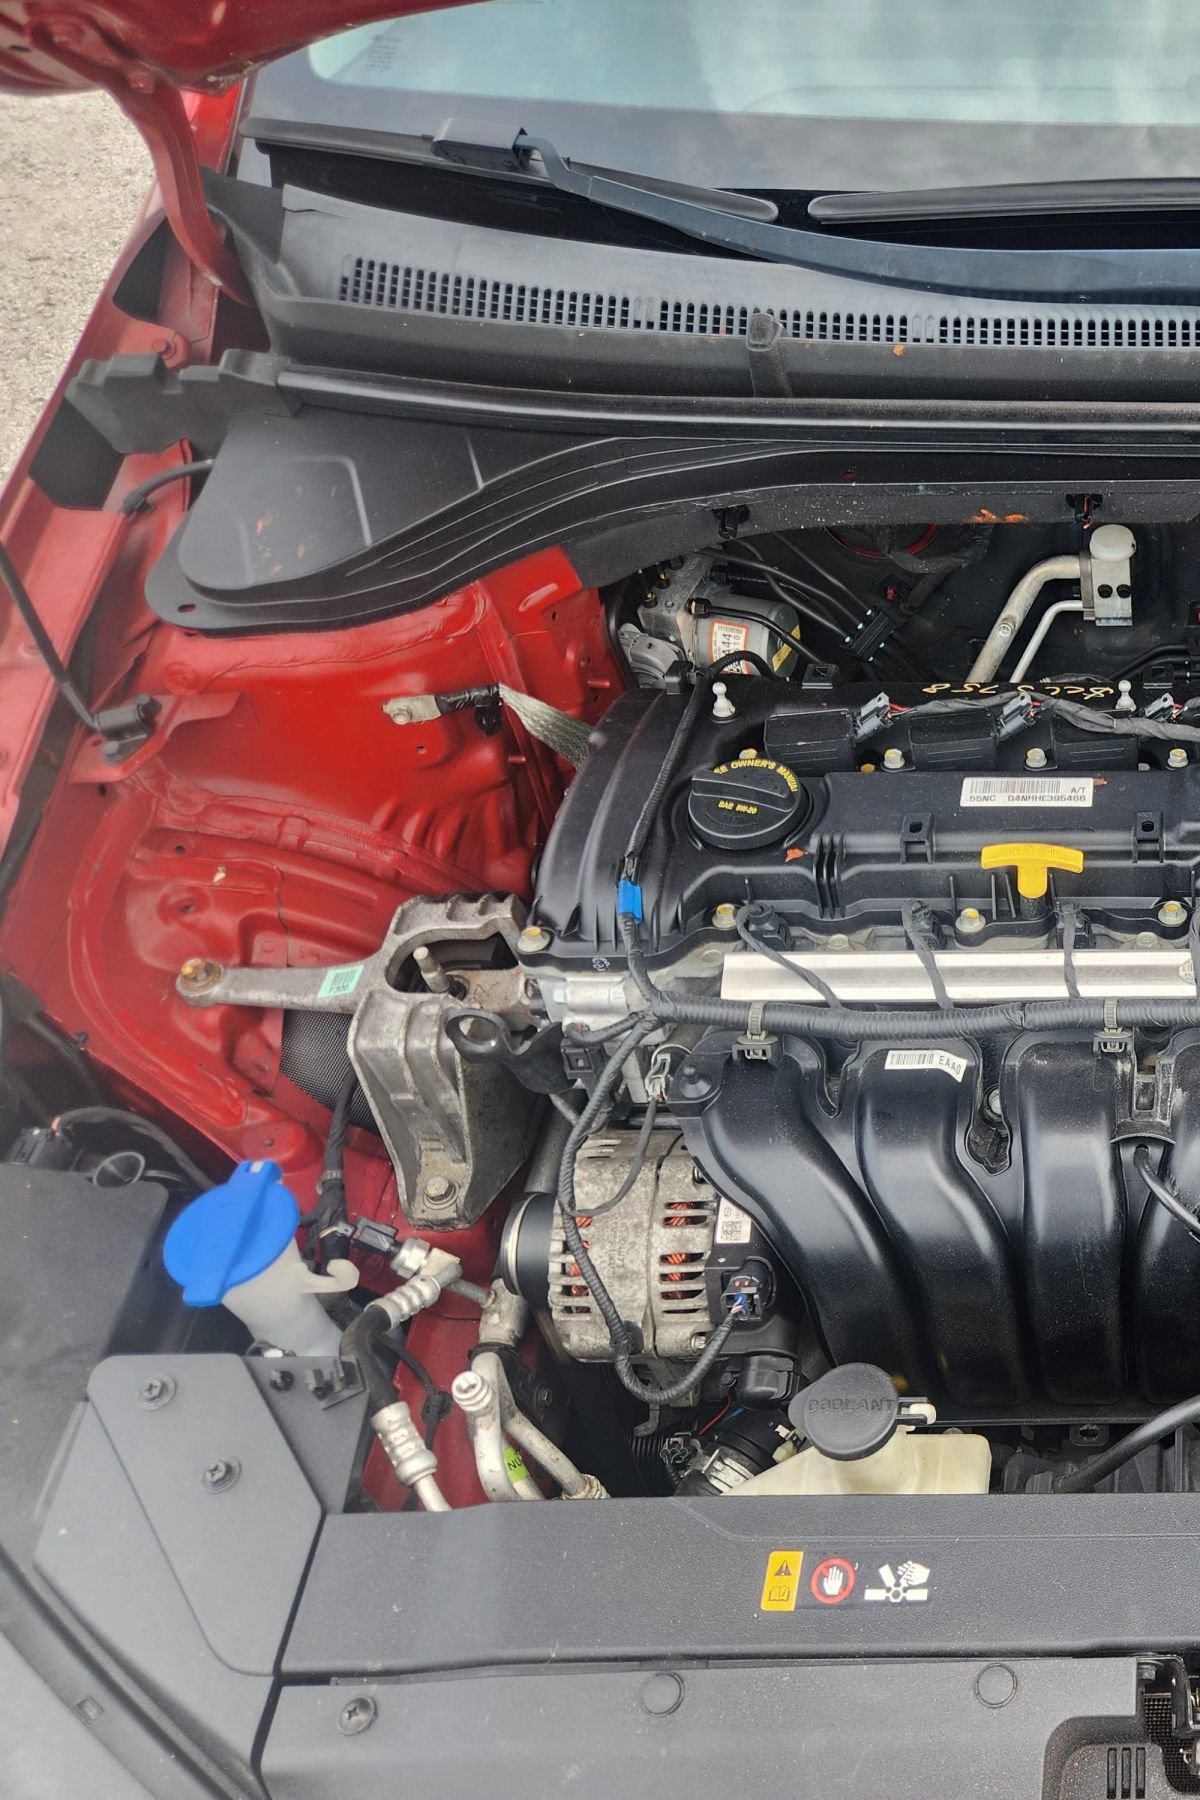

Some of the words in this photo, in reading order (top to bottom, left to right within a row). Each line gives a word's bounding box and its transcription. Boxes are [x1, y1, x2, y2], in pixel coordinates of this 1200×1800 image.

[730, 759, 776, 770] OWNER'S
[718, 800, 735, 810] SAE
[808, 1398, 896, 1414] COOLANT
